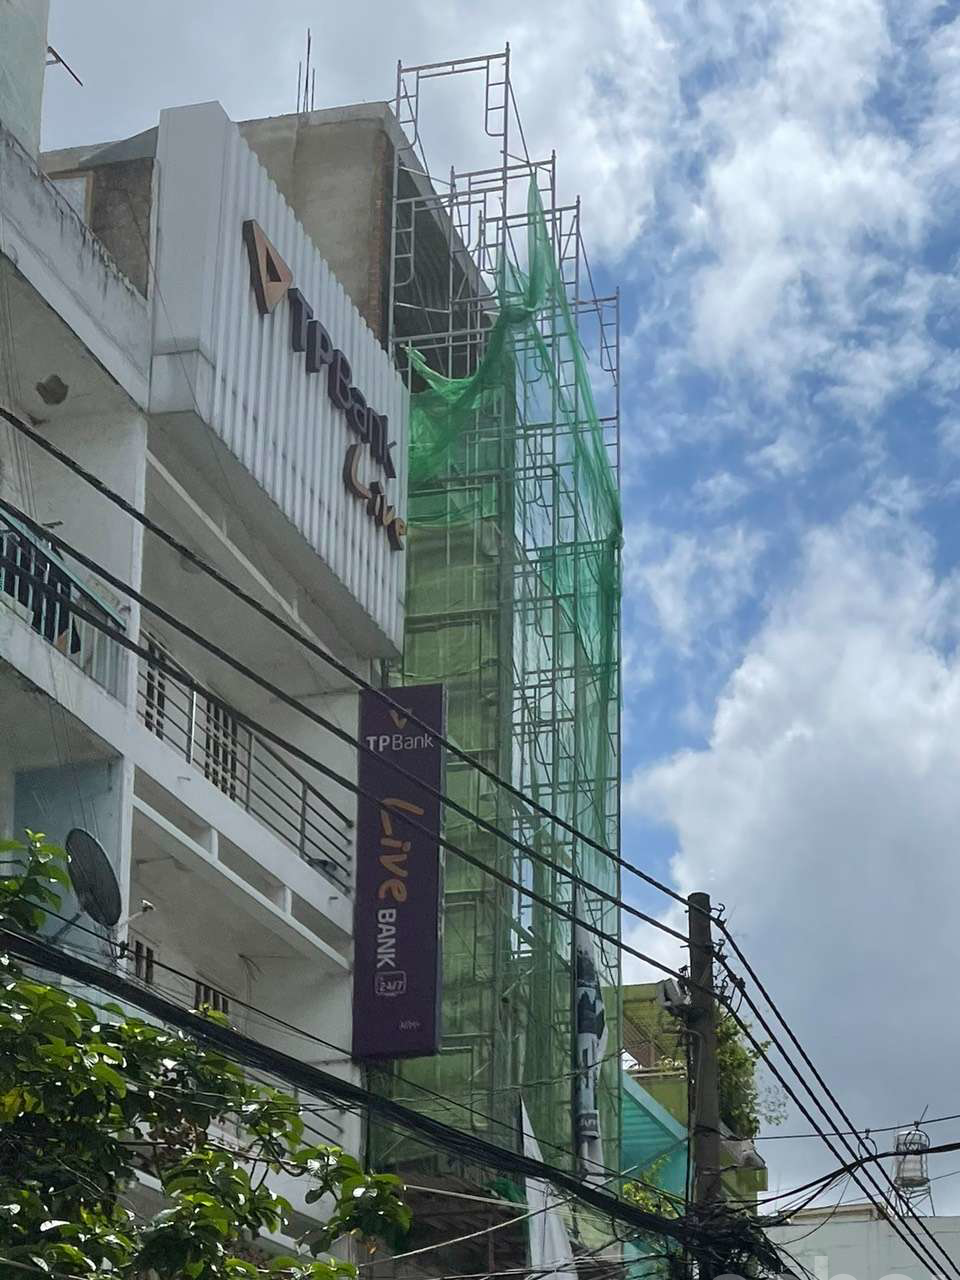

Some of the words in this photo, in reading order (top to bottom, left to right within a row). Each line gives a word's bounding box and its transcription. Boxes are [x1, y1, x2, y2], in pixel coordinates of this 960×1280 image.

[366, 732, 435, 752] TPBank
[378, 797, 425, 903] Live
[376, 908, 397, 969] BANK
